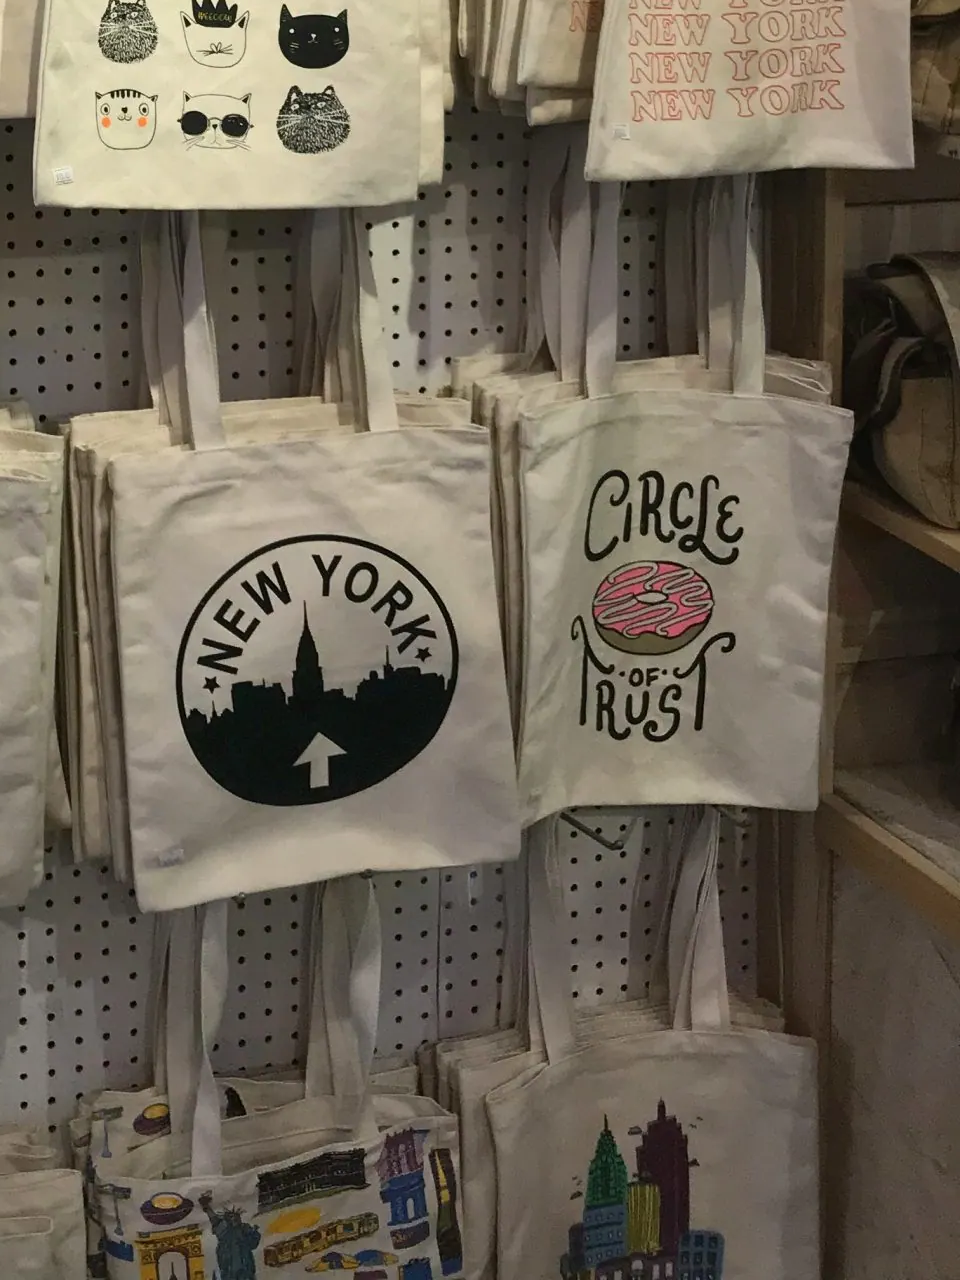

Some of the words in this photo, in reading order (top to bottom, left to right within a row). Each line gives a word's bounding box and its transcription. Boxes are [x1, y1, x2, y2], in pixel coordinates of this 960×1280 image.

[628, 13, 711, 46] NEW
[721, 6, 846, 45] YORK
[629, 52, 713, 84] NEW
[724, 43, 844, 82] YORK
[630, 89, 716, 122] NEW
[726, 79, 844, 118] YORK
[196, 561, 292, 675] NEW
[311, 554, 438, 655] YORK
[628, 667, 660, 688] OF
